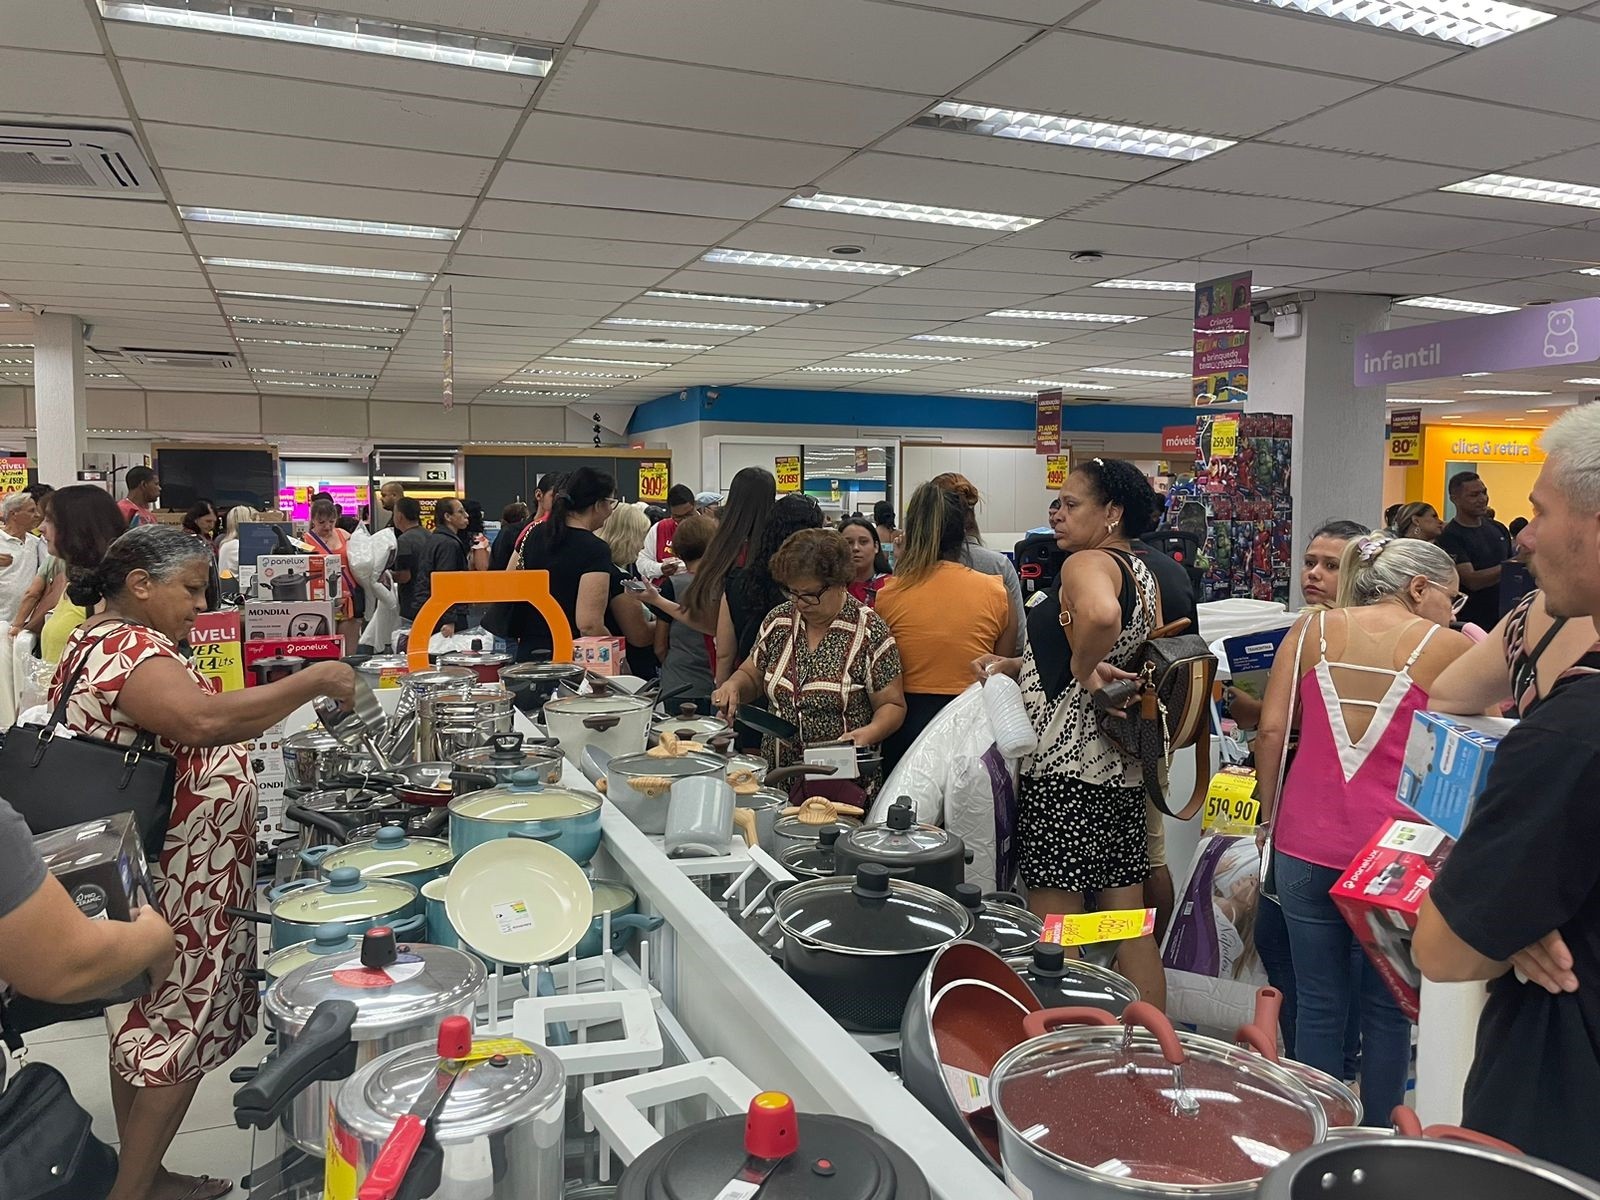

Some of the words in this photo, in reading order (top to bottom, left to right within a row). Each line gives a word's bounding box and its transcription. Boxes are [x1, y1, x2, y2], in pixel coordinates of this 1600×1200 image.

[1364, 343, 1441, 373] infantil
[1166, 434, 1196, 447] móveis
[1452, 438, 1480, 454] clica
[1483, 441, 1491, 455] &
[1494, 441, 1529, 456] retira
[270, 558, 305, 566] panelux
[295, 643, 329, 652] panelux
[1350, 849, 1380, 882] panelux
